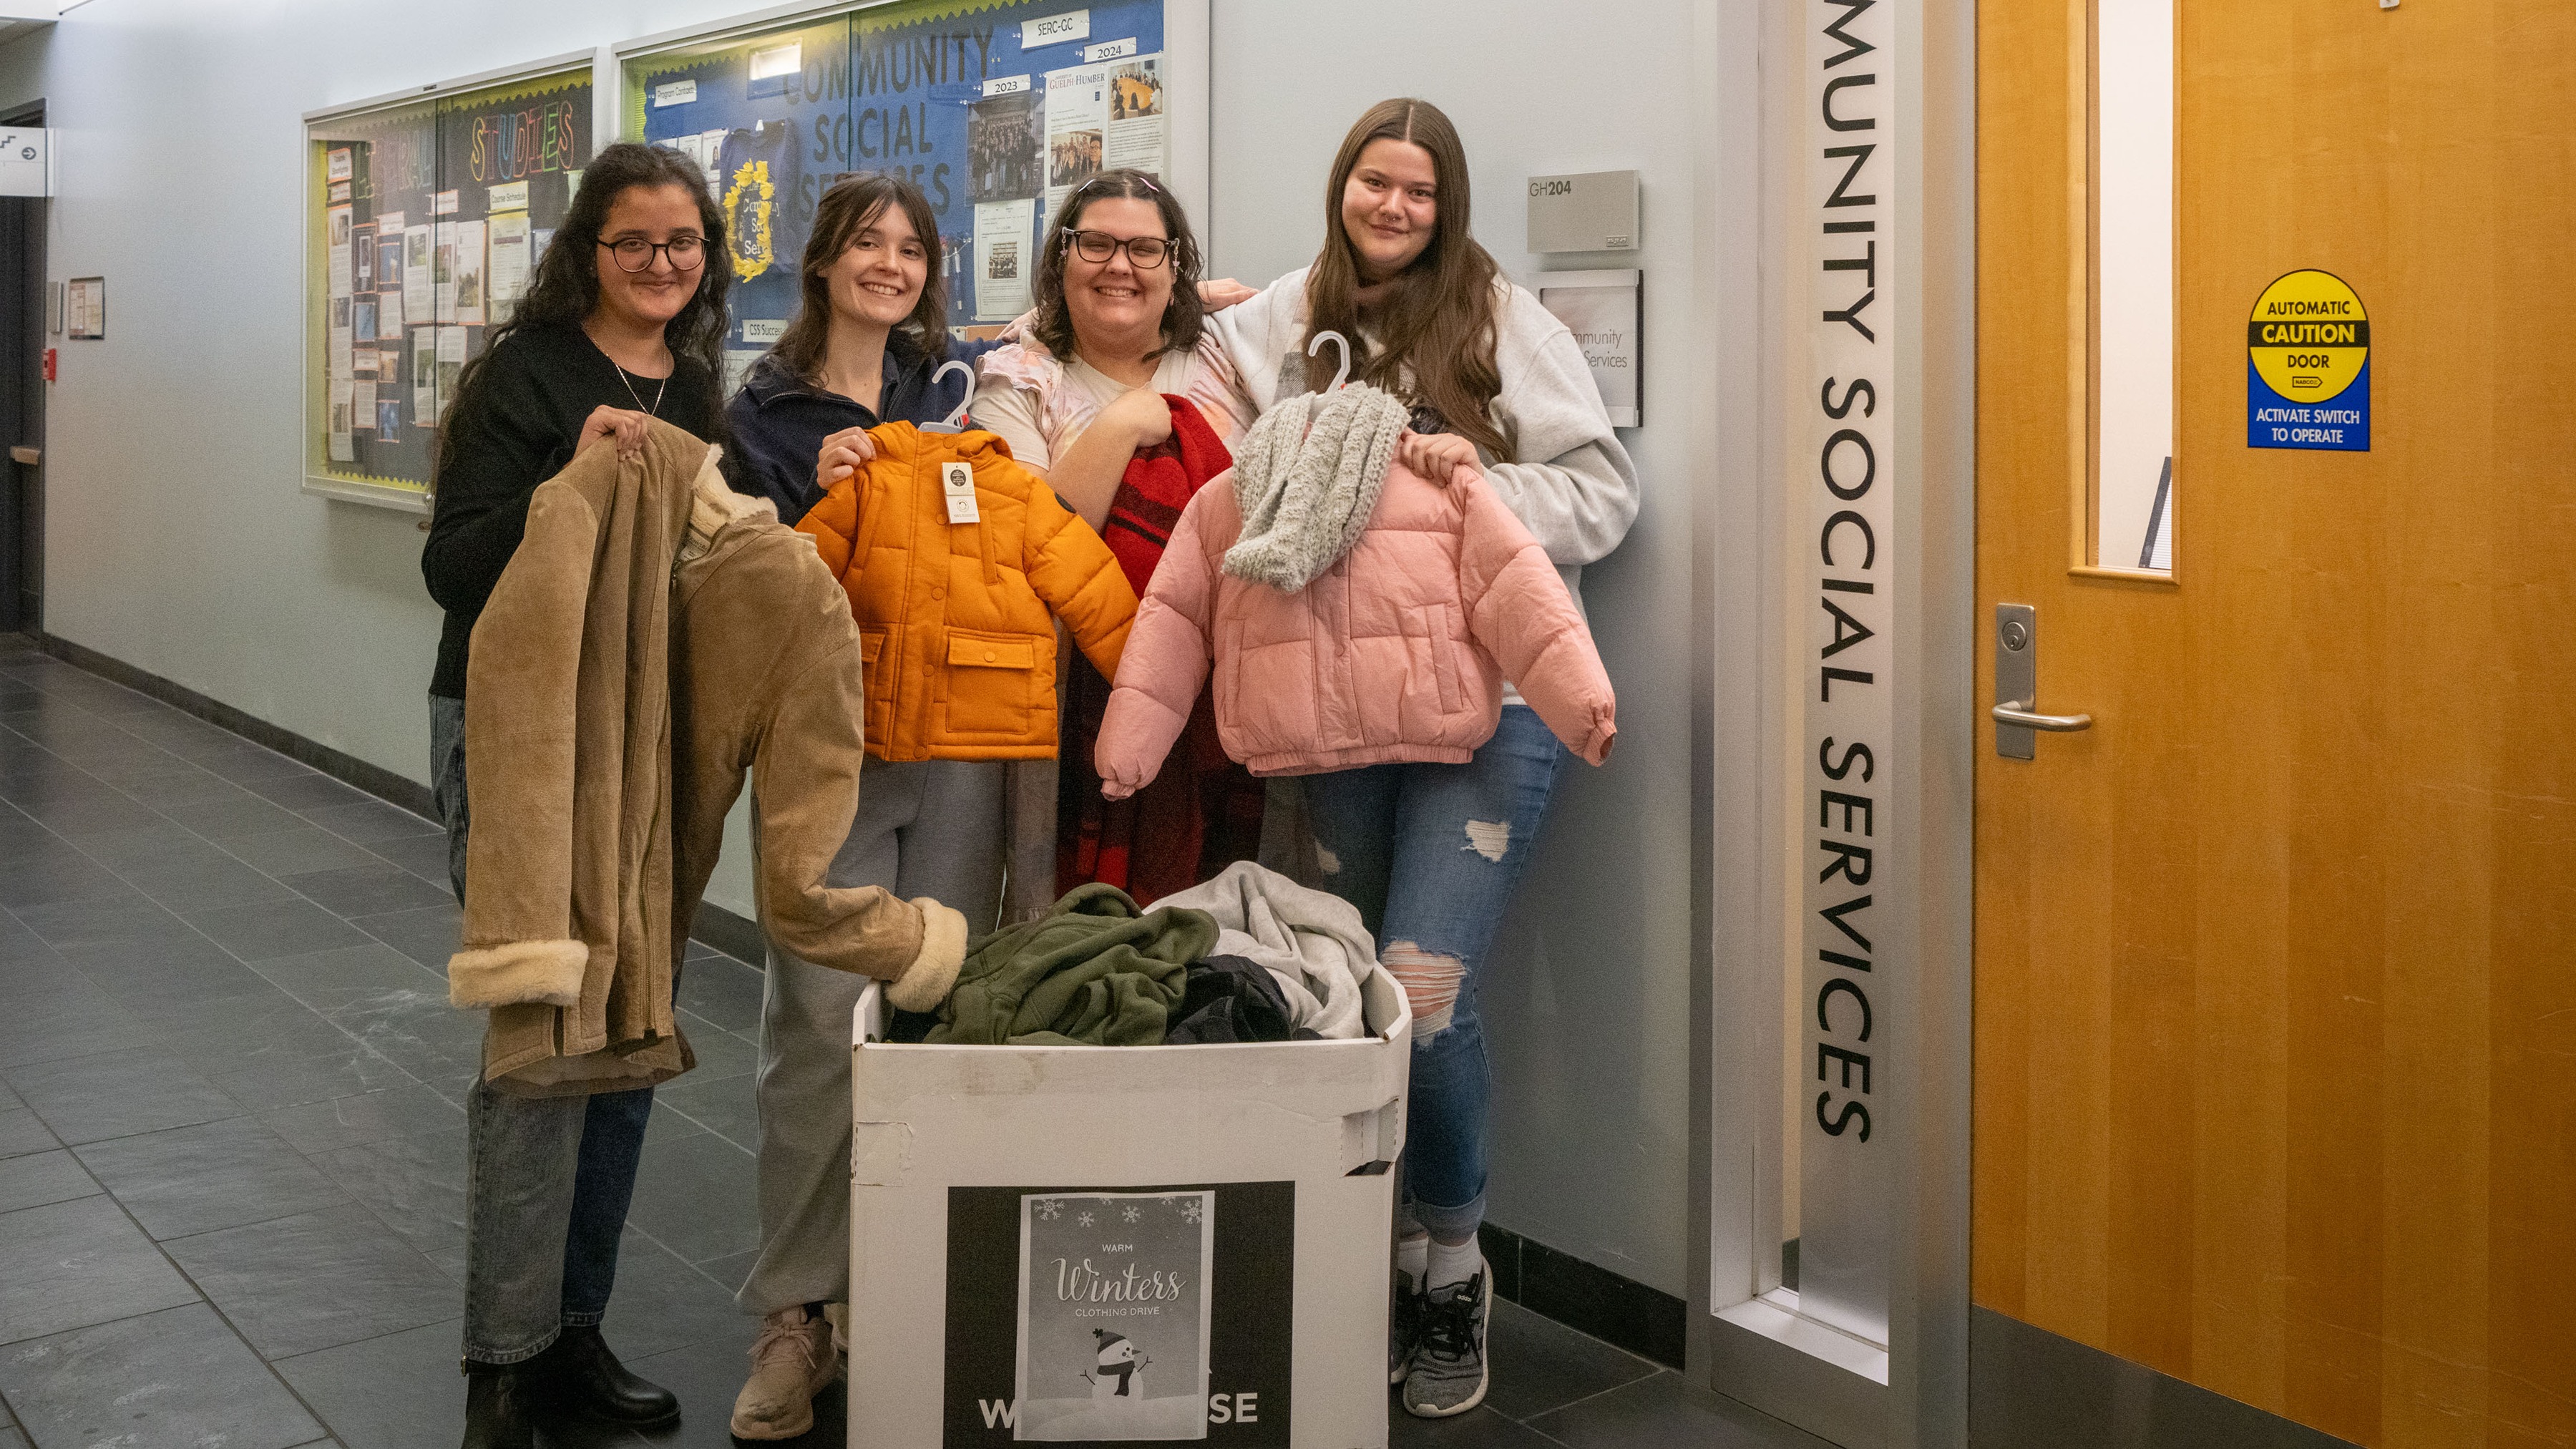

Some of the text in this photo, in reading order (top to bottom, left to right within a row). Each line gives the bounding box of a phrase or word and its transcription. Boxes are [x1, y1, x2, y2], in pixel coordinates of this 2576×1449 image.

[1038, 17, 1073, 36] SERC-GC
[1097, 45, 1122, 59] 2024
[995, 81, 1018, 93] 2023
[814, 102, 933, 163] SOCIAL
[471, 100, 574, 182] STUDIES
[1529, 181, 1572, 197] GH204
[2267, 301, 2351, 315] AUTOMATIC
[749, 323, 760, 336] CSS
[2261, 324, 2355, 343] CAUTION
[2288, 354, 2331, 369] DOOR
[2255, 408, 2360, 424] ACTIVATE SWITCH
[2271, 428, 2343, 443] TO OPERATE
[1821, 375, 1875, 703] SOCIAL
[1815, 735, 1875, 1143] SERVICES
[1102, 1244, 1133, 1252] WARM
[1050, 1257, 1187, 1303] Winters
[1075, 1307, 1161, 1317] CLOTHING DRIVE
